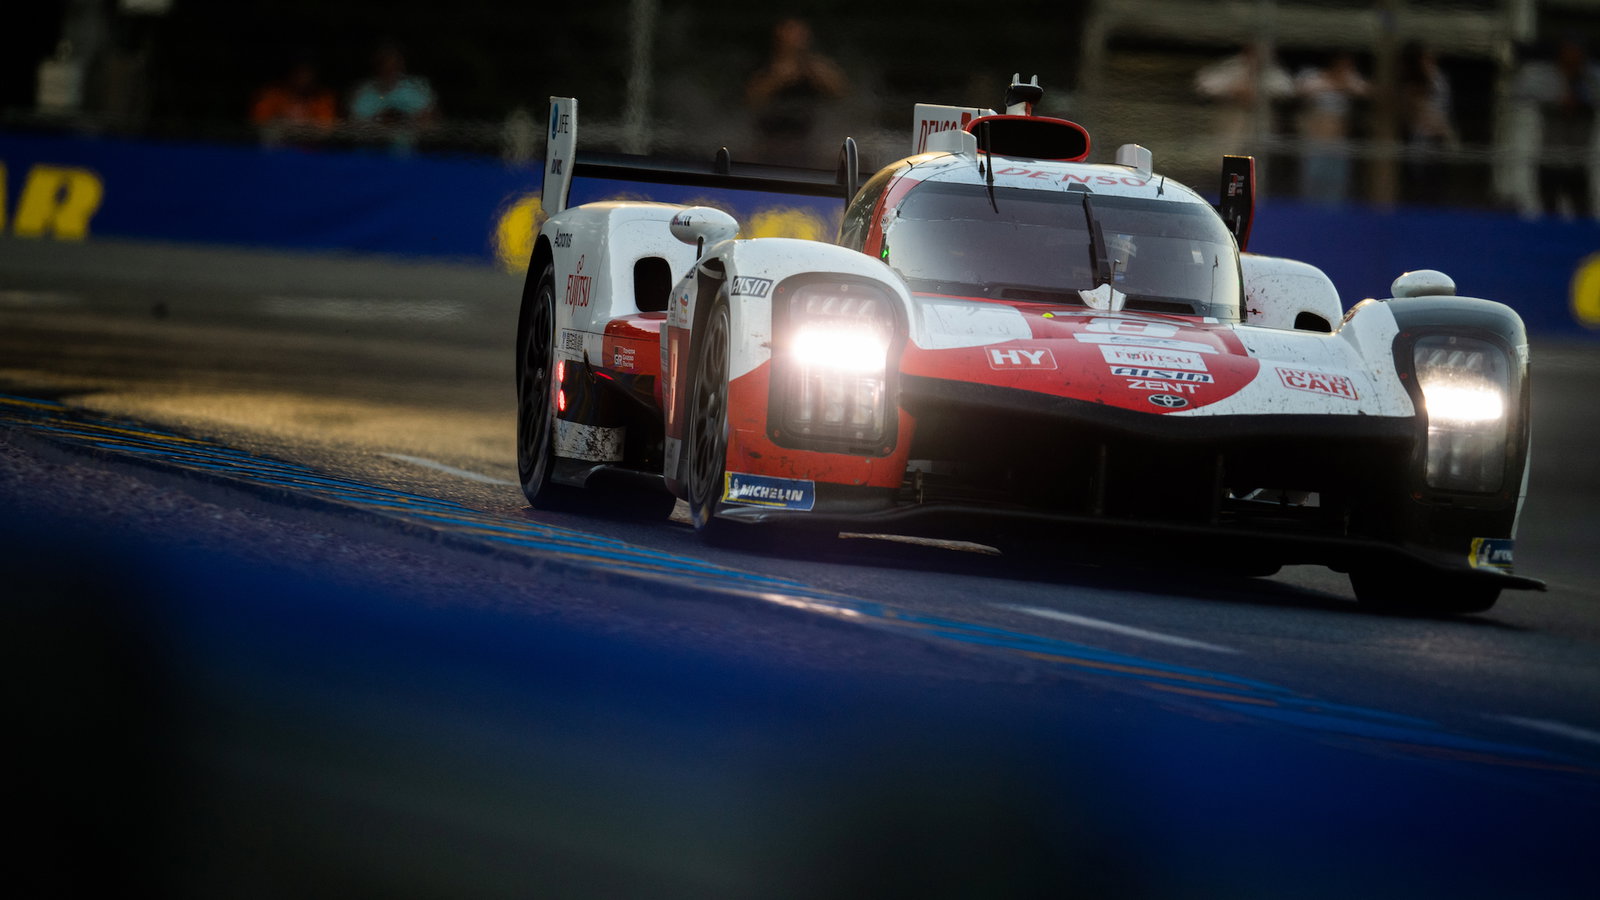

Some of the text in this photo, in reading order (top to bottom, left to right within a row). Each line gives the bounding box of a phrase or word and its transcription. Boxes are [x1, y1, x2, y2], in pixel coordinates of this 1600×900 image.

[994, 166, 1146, 187] DENSO
[565, 274, 592, 316] FUJITSU
[732, 276, 771, 297] AISIN
[991, 349, 1045, 365] HY
[1114, 351, 1192, 364] FUJITSU
[1114, 367, 1210, 382] AISIN
[1126, 379, 1201, 394] ZENT
[1286, 376, 1352, 396] CAR
[738, 483, 804, 502] MICHELIN
